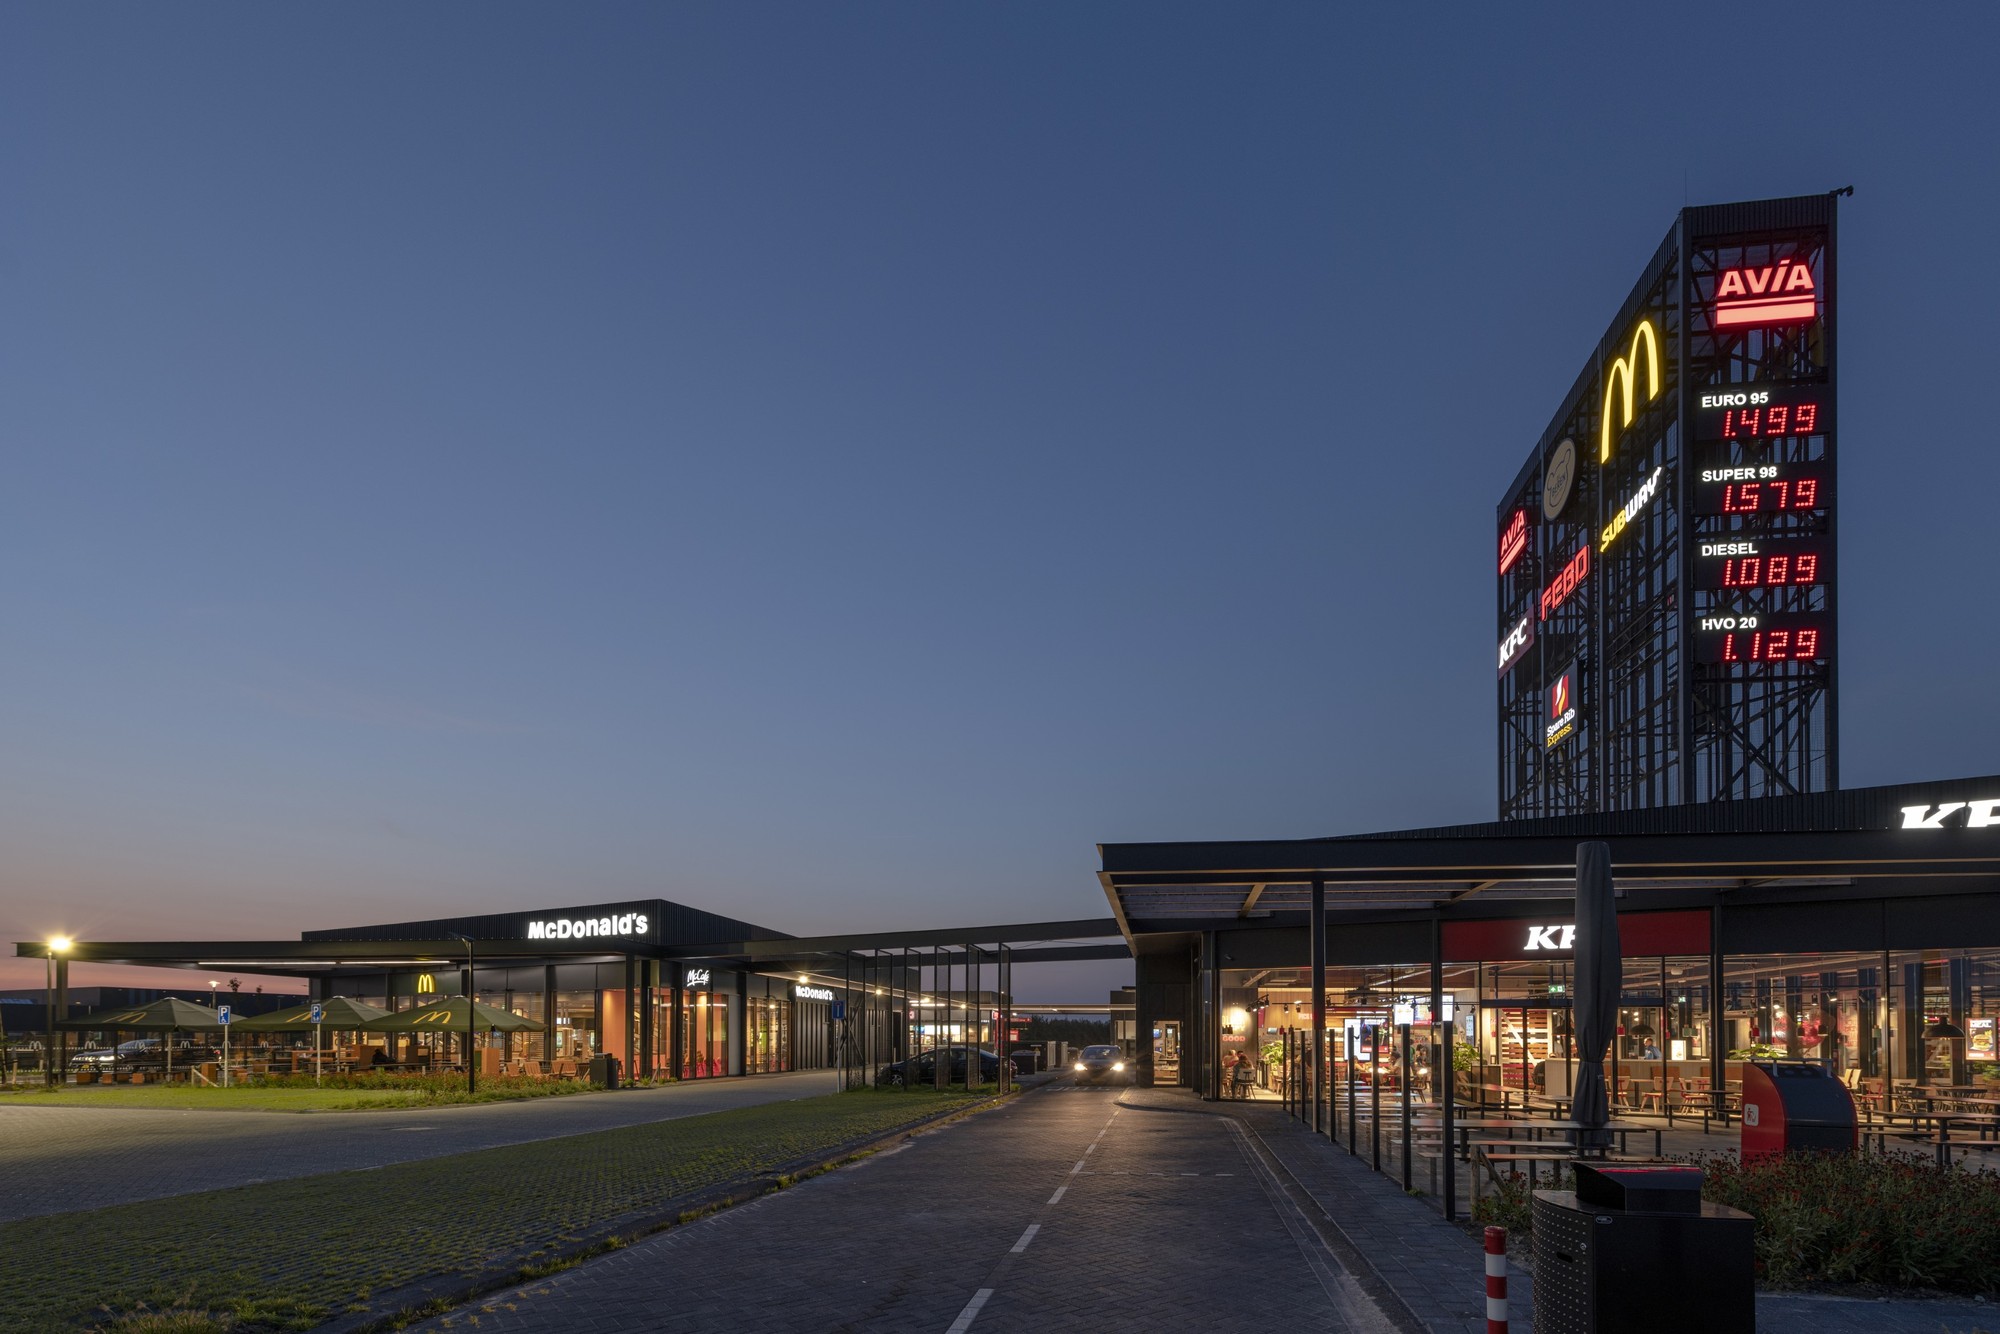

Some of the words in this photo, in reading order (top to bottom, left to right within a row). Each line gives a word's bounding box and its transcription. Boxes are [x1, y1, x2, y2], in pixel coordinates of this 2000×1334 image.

[1702, 393, 1747, 408] EURO
[1750, 391, 1768, 405] 95
[1725, 404, 1815, 437] 1.499
[1702, 468, 1756, 483] SUPER
[1759, 466, 1777, 479] 98
[1600, 466, 1661, 552] SUBWAY
[1724, 480, 1816, 512] 1.579
[1702, 543, 1758, 557] DIESEL
[1542, 546, 1590, 621] FEBO
[1724, 555, 1816, 586] 1.089
[1702, 618, 1735, 631] HVO
[1740, 617, 1757, 629] 20
[1499, 618, 1528, 668] KFC
[1724, 630, 1816, 660] 1.129
[1547, 718, 1564, 737] Spare
[1564, 708, 1575, 723] Rib
[528, 912, 649, 940] McDonald's
[795, 985, 833, 1001] McDonald's
